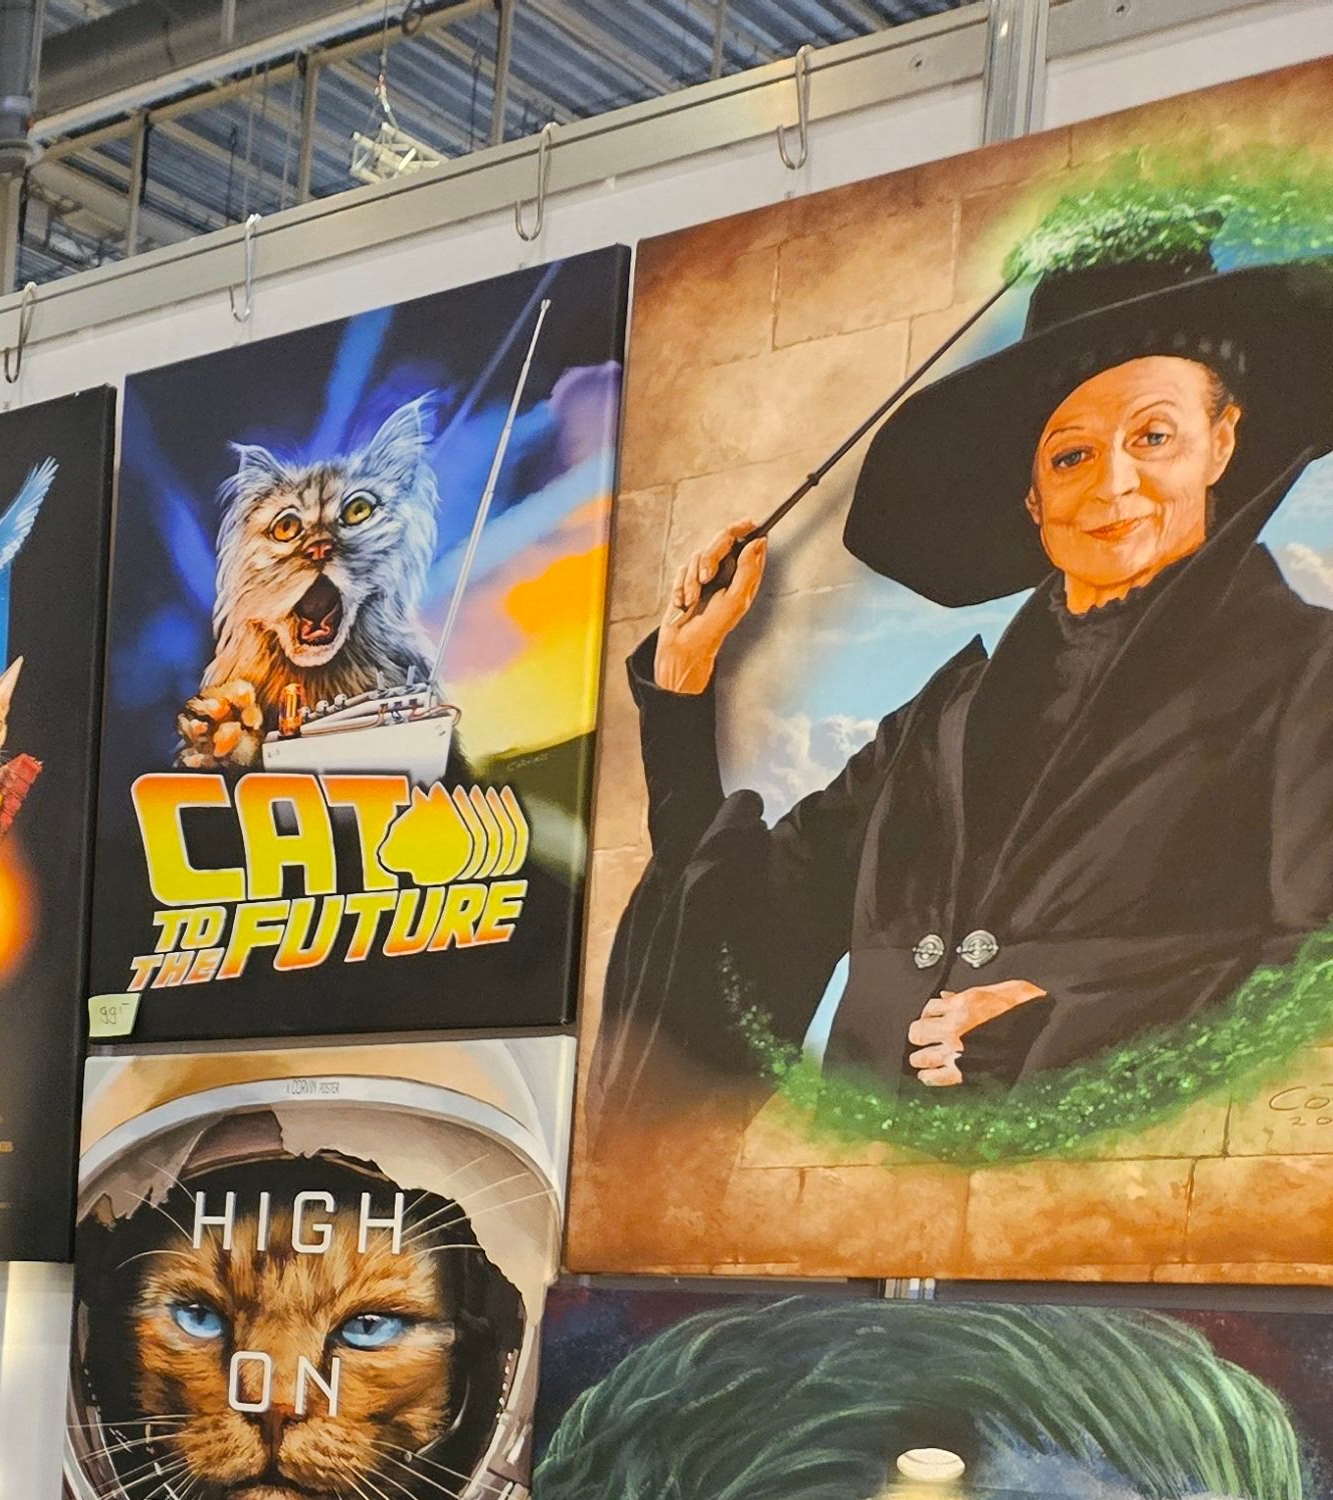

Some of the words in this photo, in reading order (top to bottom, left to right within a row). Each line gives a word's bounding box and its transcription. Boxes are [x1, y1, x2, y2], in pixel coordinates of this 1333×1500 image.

[131, 773, 411, 906] CAT
[153, 906, 227, 953] TO
[217, 879, 529, 979] FUTURE
[127, 947, 223, 992] THE
[193, 1190, 404, 1253] HIGH
[228, 1350, 340, 1417] ON
